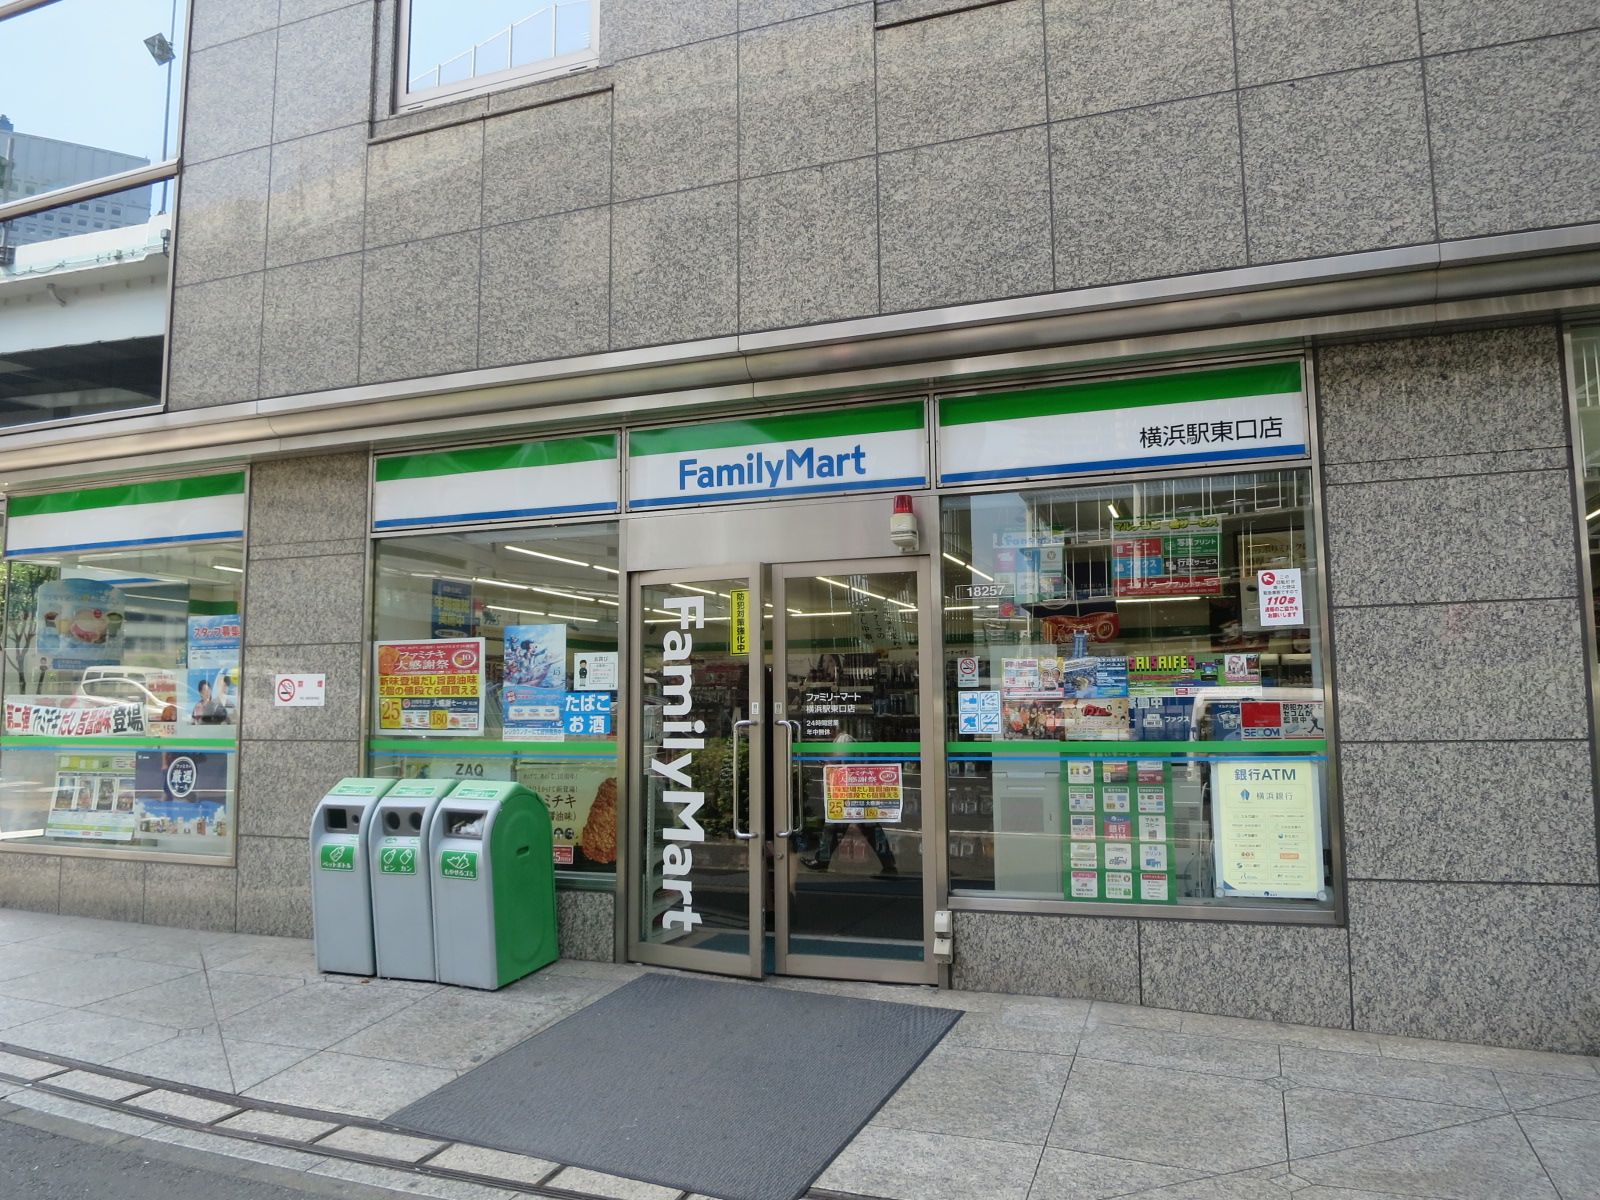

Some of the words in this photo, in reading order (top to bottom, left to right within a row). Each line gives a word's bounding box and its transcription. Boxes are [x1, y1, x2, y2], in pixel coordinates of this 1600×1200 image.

[1139, 416, 1283, 449] 横浜駅東口店
[679, 444, 867, 490] FamilyMart
[966, 586, 1006, 597] 18257
[736, 592, 746, 653] 防犯対策強化中
[400, 650, 446, 660] ファミチキ
[394, 660, 449, 671] 大感謝祭
[565, 693, 610, 712] たばこ
[806, 692, 862, 702] ファミリーマート
[806, 704, 856, 713] 横浜駅東口店
[569, 715, 605, 734] お酒
[806, 719, 840, 727] 24時間営業
[1244, 728, 1280, 737] SECOM
[651, 595, 705, 932] FamilyMart
[1234, 768, 1296, 781] 銀行ATM
[1256, 792, 1293, 801] 横浜銀行
[1109, 825, 1126, 833] 銀行
